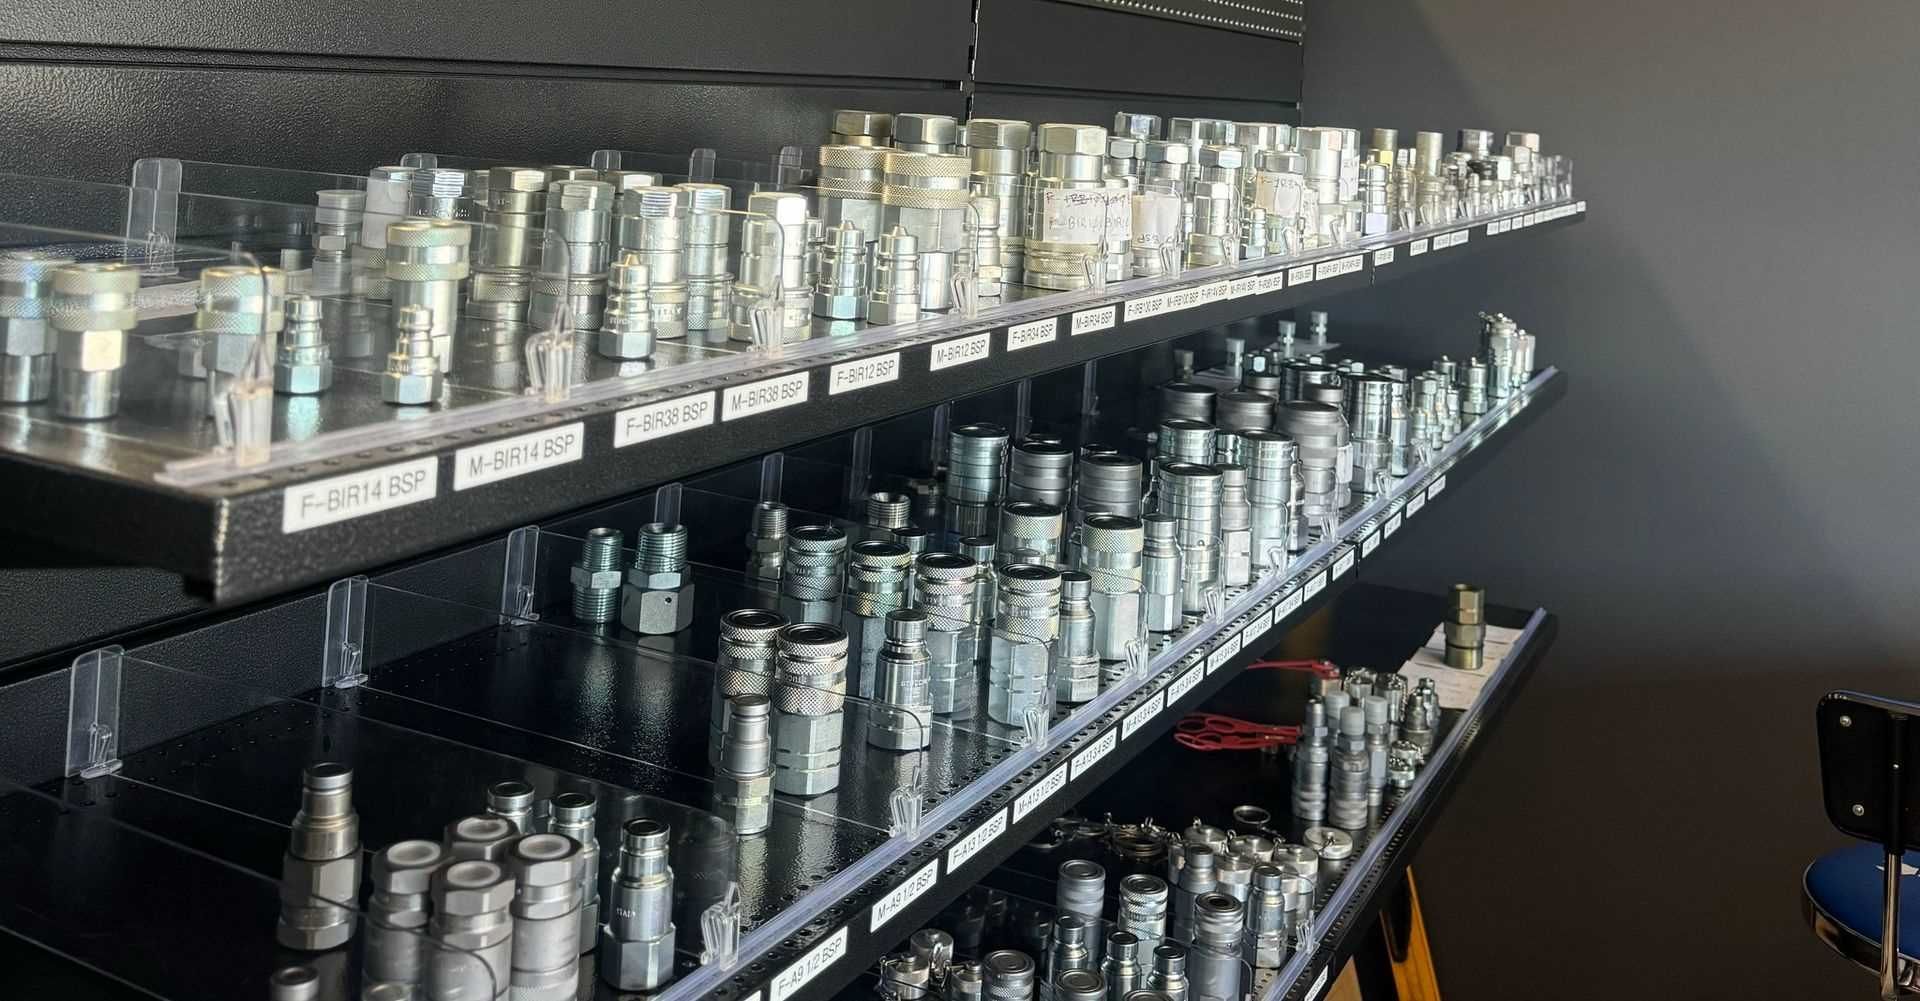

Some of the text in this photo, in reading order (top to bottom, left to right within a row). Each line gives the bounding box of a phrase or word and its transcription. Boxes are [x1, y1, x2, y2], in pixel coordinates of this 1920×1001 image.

[1012, 323, 1054, 345] F-BIR34 BSP
[1075, 310, 1113, 330] M-BIR34 BSP
[936, 338, 986, 364] M-BIR12 BSP
[837, 362, 896, 387] F-BIR12 BSP
[731, 380, 804, 412] M-BIR38 BSP
[625, 401, 709, 437] F-BIR38 BSP
[469, 433, 576, 479] M-BIR14 BSP
[301, 470, 427, 518] F-BIR14 BSP
[1050, 770, 1064, 789] BSP
[953, 817, 1004, 864] F-A13 1/2 BSP
[877, 868, 933, 921] M-A9 1/2 BSP
[778, 937, 841, 998] F-A9 1/2 BSP
